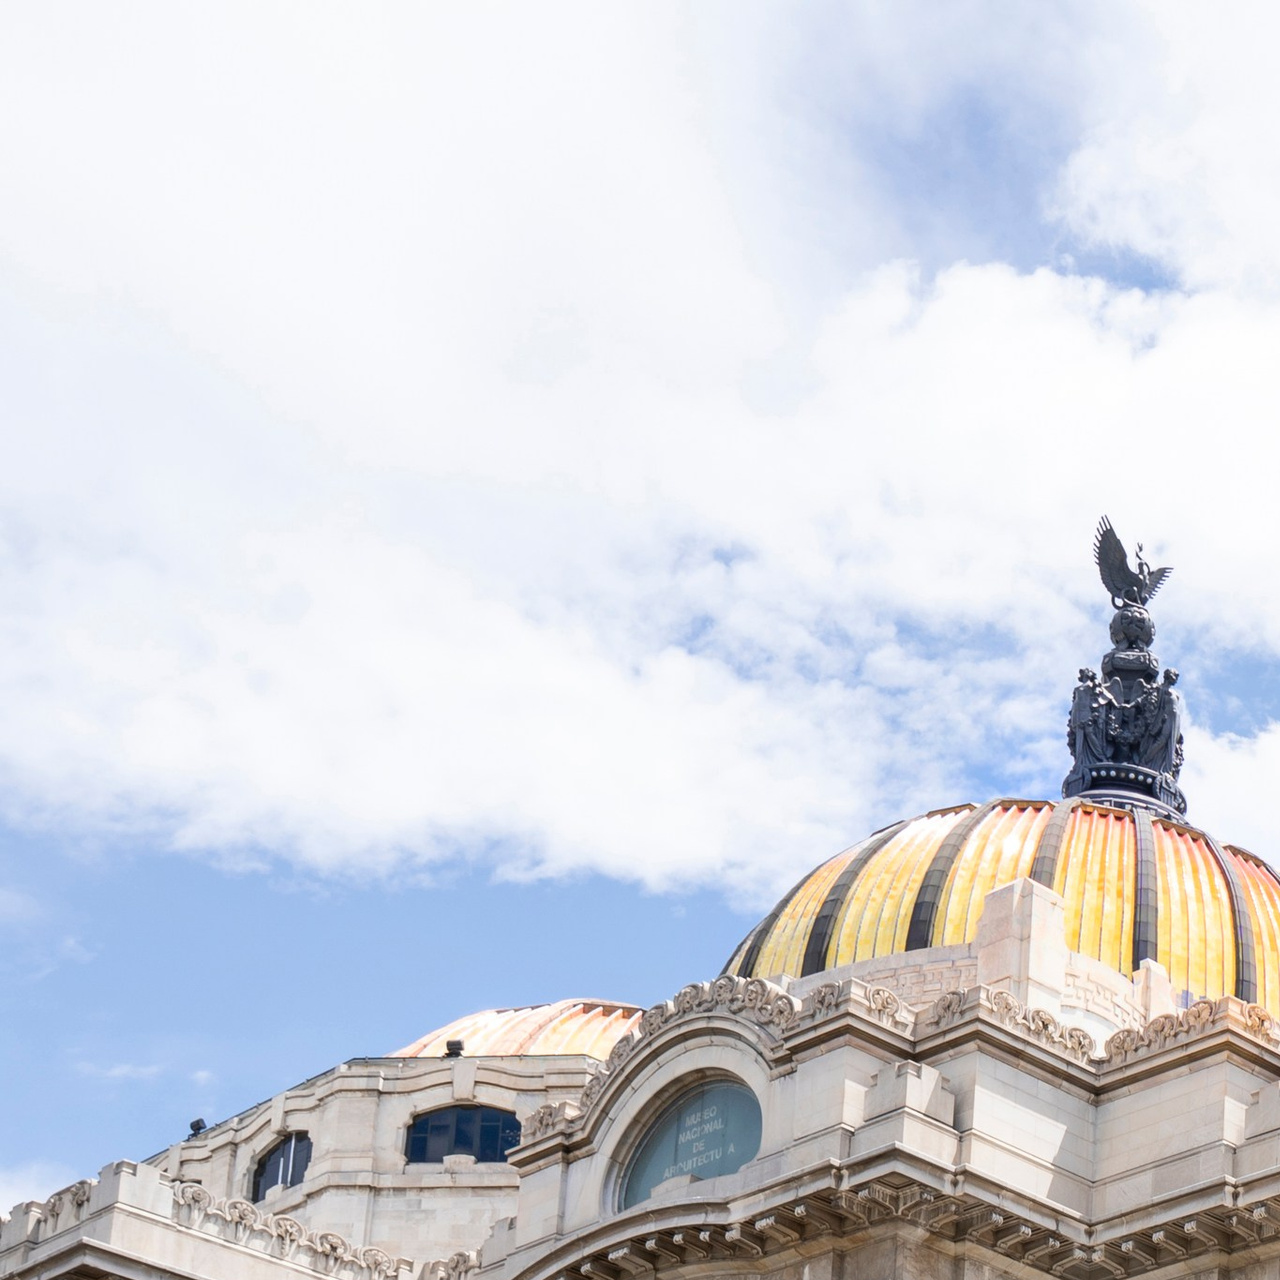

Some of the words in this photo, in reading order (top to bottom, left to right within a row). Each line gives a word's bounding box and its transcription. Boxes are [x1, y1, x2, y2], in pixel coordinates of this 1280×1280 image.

[685, 1105, 717, 1127] MUSEO
[678, 1118, 724, 1144] NACIONAL
[692, 1139, 706, 1154] DE
[663, 1143, 735, 1179] ARQUITECTUA
